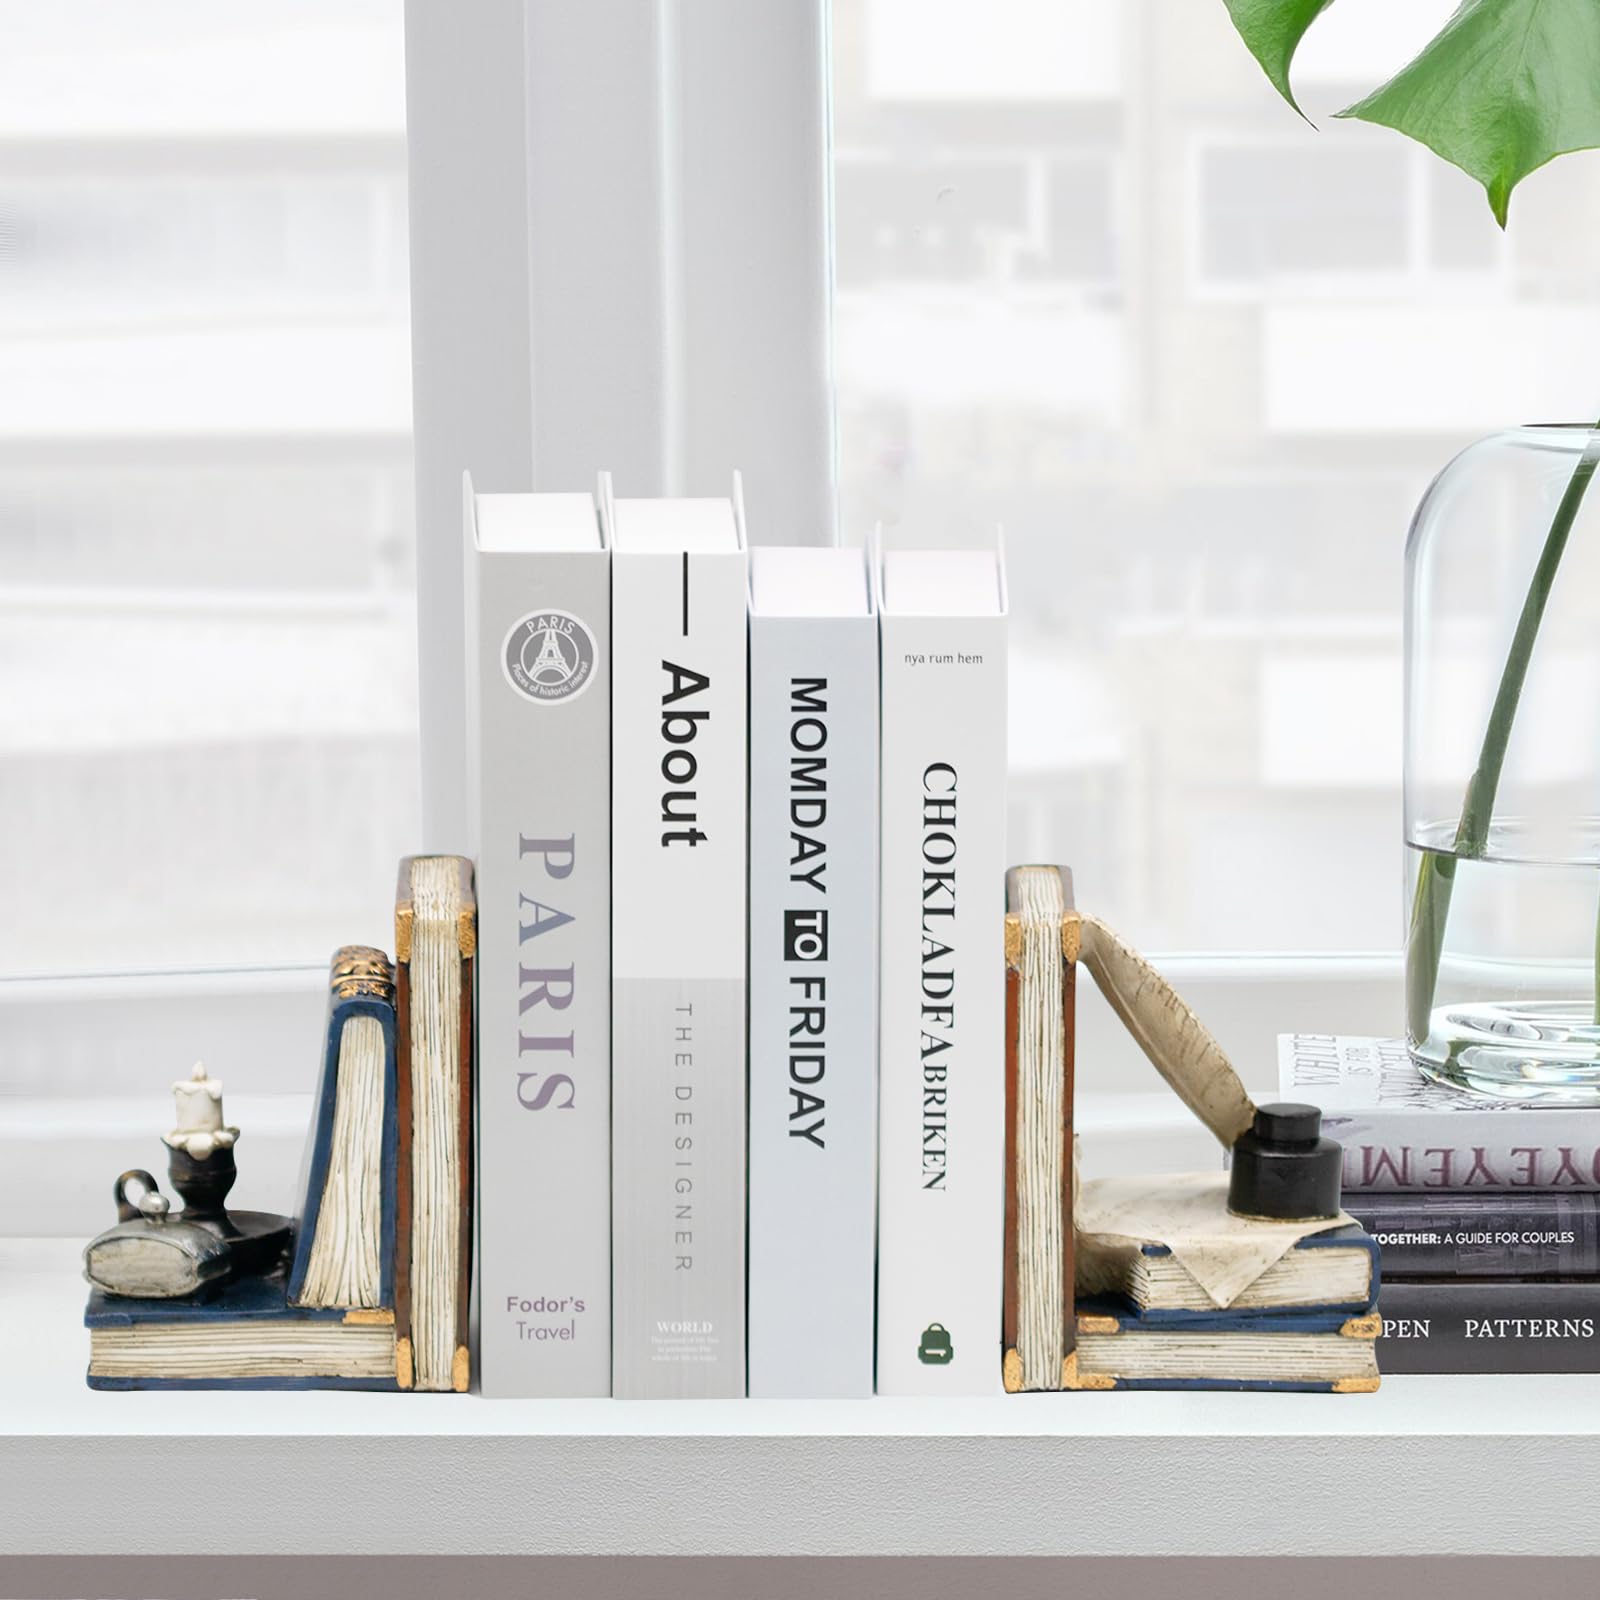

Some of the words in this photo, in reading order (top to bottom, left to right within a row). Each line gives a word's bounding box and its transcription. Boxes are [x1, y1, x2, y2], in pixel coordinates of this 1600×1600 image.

[525, 615, 576, 634] PARIS
[511, 663, 530, 688] Places
[528, 683, 541, 693] of
[539, 685, 570, 696] historic
[567, 660, 590, 689] interest
[904, 653, 925, 667] nya
[929, 653, 954, 664] rum
[957, 651, 984, 664] hem
[661, 659, 711, 847] About
[789, 677, 828, 895] MOMDAY
[793, 910, 824, 961] TO
[517, 832, 576, 1111] PARIS
[920, 762, 958, 1192] CHOKLADFABRIKEN
[674, 1002, 693, 1066] THE
[788, 976, 827, 1150] FRIDAY
[674, 1086, 693, 1271] DESIGNER
[1443, 1232, 1454, 1245] A
[1455, 1232, 1493, 1244] GUIDE
[1495, 1232, 1519, 1244] FOR
[1521, 1231, 1575, 1243] COUPLES
[515, 1319, 576, 1341] Travel
[656, 1320, 713, 1333] WORLD
[1464, 1318, 1595, 1338] PATTERNS
